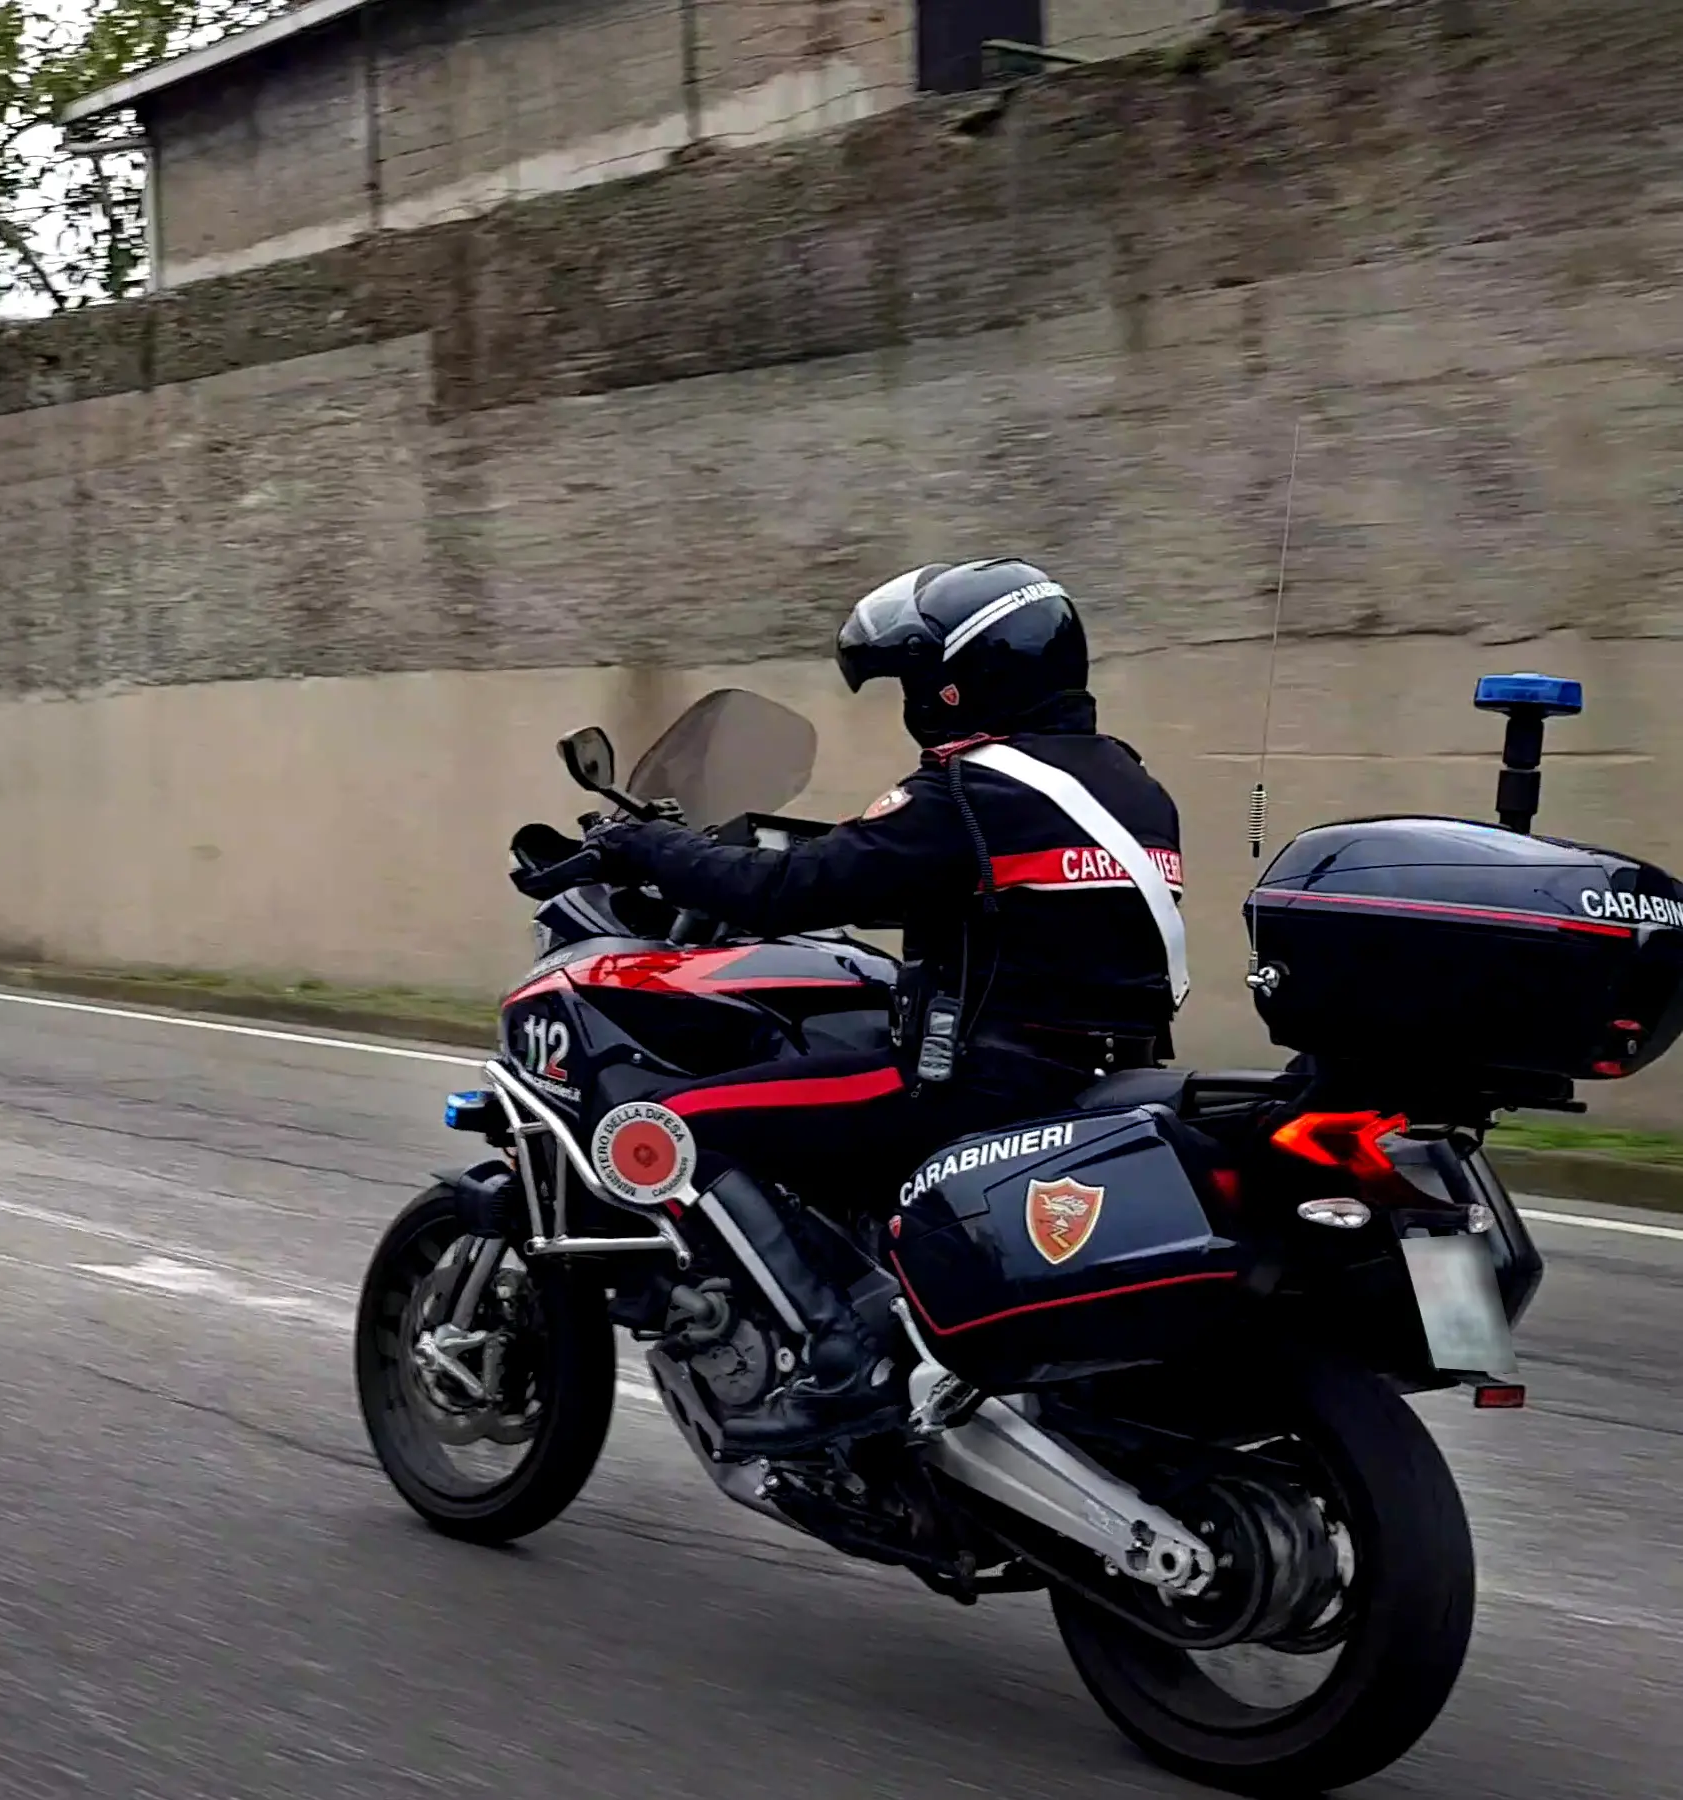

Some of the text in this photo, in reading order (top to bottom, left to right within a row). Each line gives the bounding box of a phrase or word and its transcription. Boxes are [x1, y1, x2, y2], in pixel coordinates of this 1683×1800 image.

[523, 1014, 568, 1082] 112
[597, 1107, 685, 1197] MINISTERO DELLA DIFESA
[899, 1123, 1074, 1207] CARABINIERI
